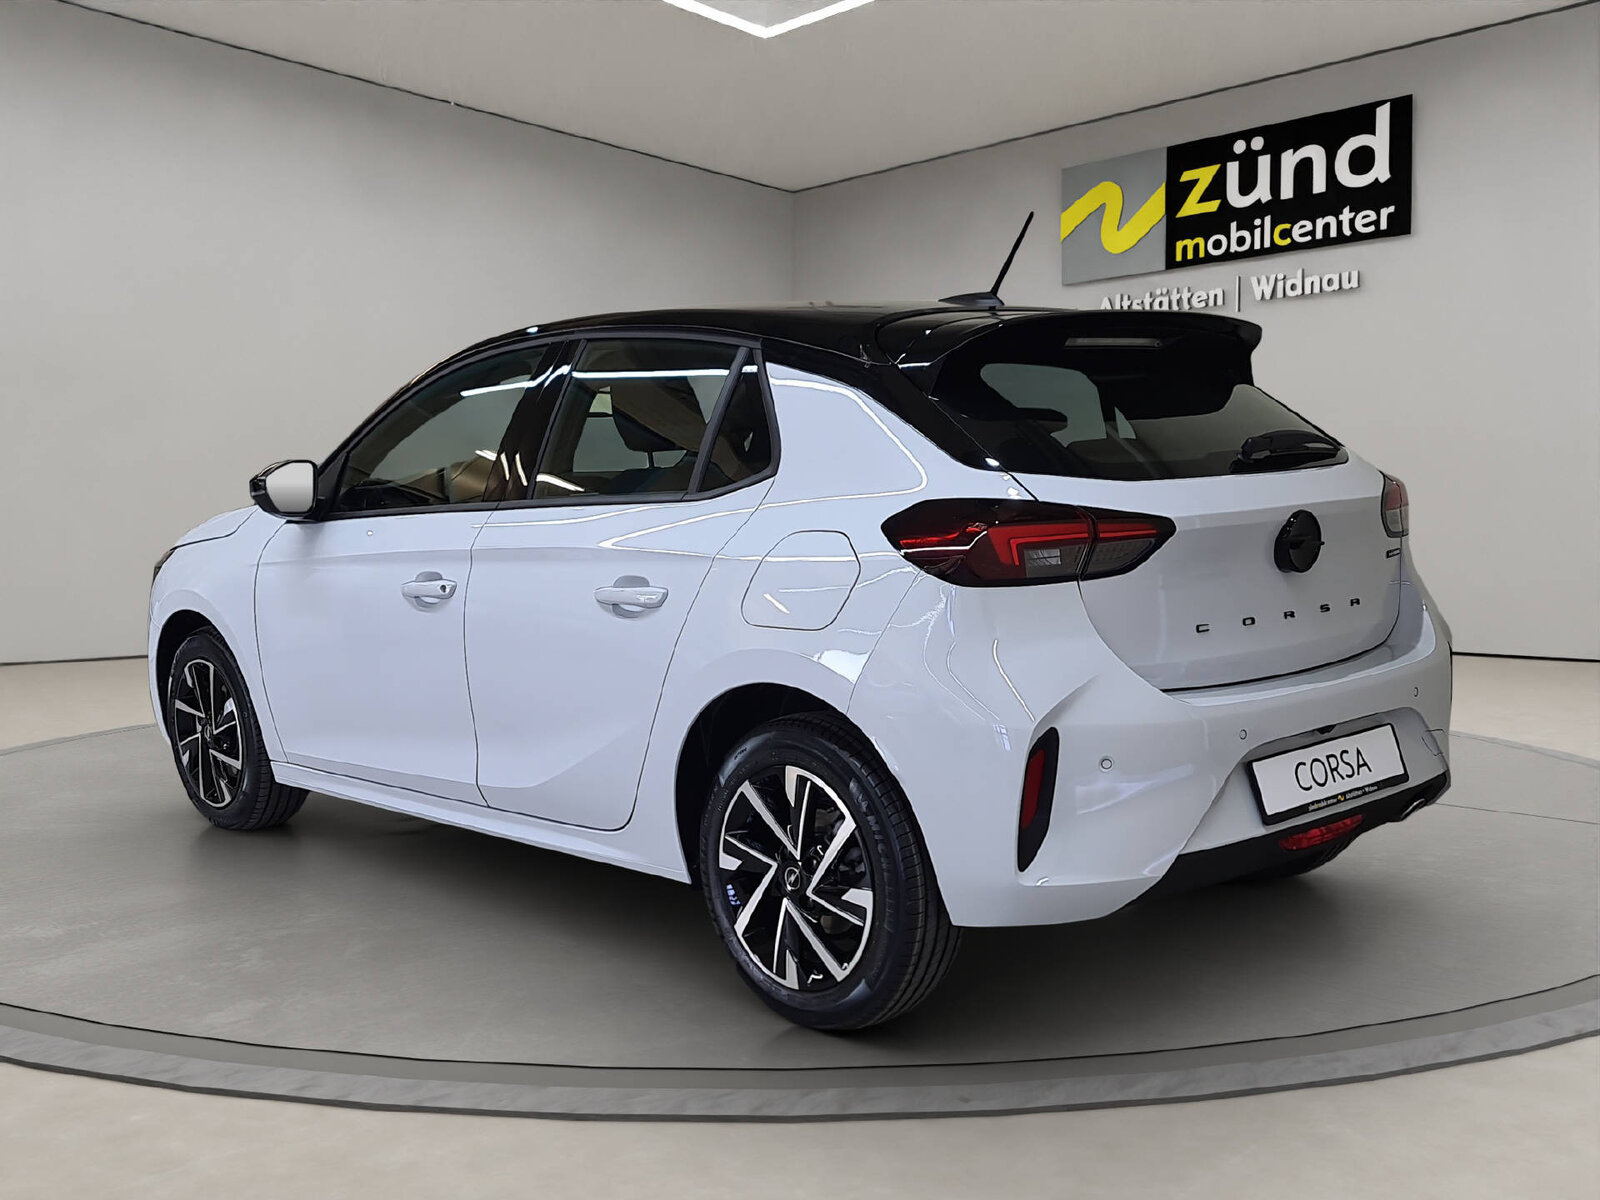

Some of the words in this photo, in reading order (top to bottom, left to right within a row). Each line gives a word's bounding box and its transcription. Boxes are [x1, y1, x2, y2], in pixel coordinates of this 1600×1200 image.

[1175, 101, 1391, 219] zünd
[1175, 204, 1396, 262] mobilcenter
[1100, 284, 1226, 311] Altstätten
[1250, 267, 1360, 302] Widnau
[1196, 597, 1361, 634] CORSA
[1294, 746, 1373, 792] CORSA
